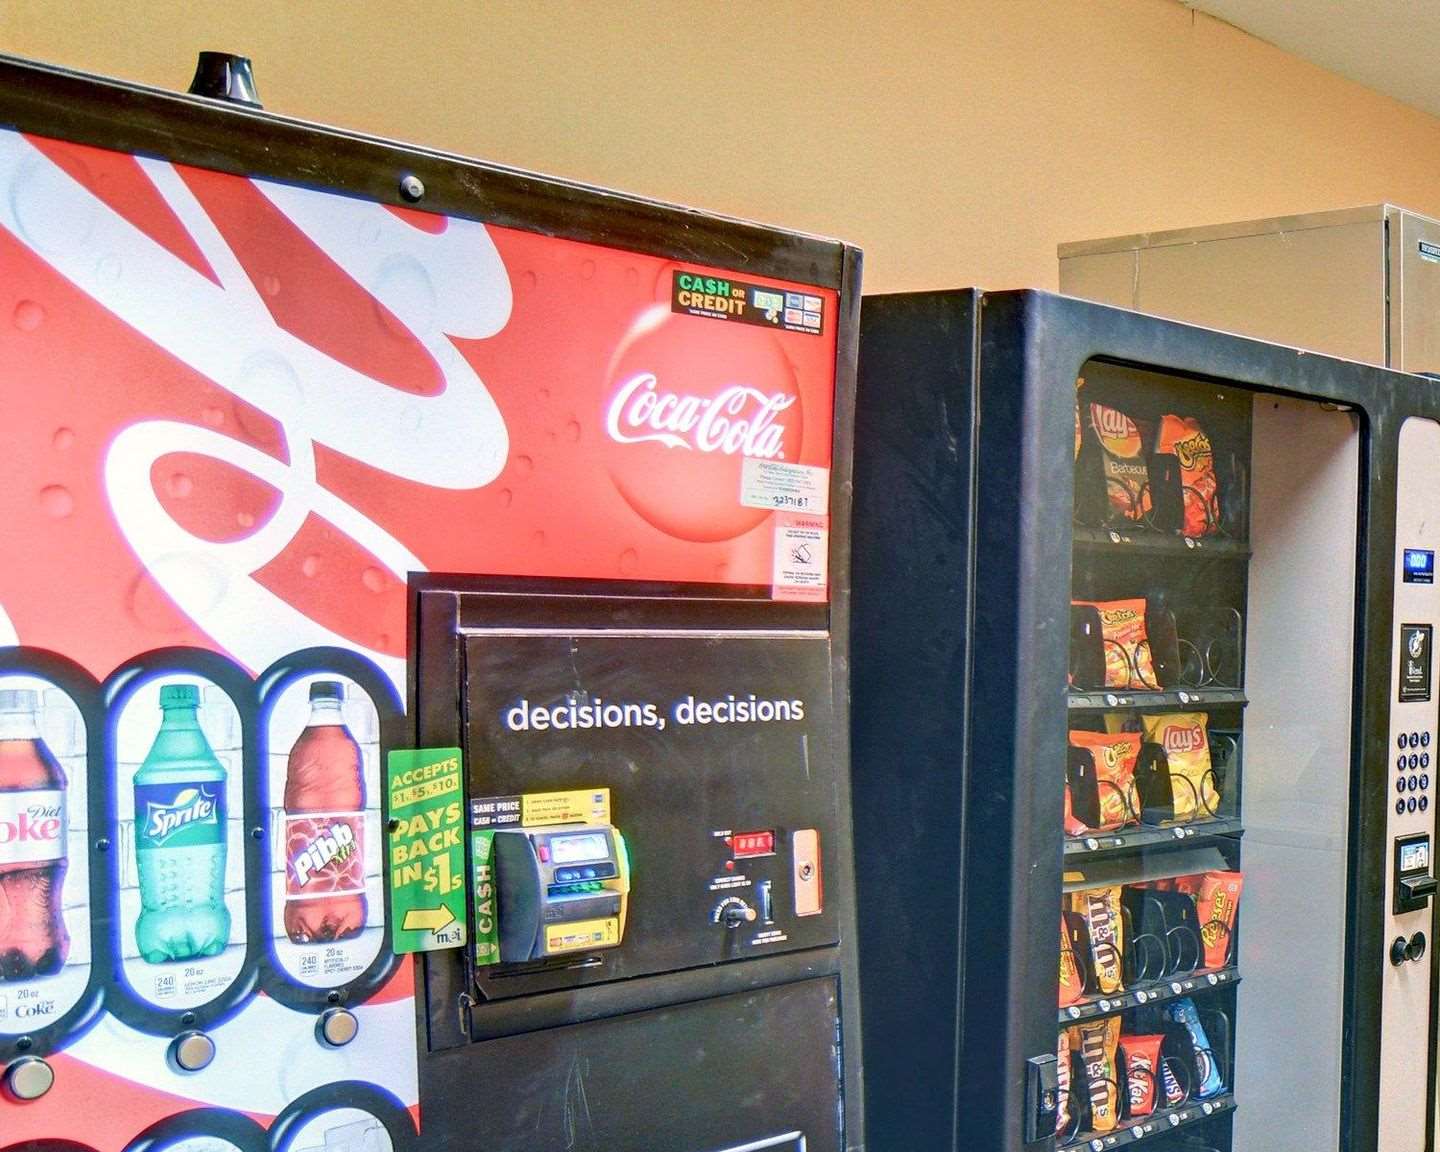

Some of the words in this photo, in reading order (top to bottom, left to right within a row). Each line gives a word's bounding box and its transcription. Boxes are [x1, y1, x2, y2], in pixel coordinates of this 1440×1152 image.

[678, 290, 746, 315] CREDIT
[732, 288, 745, 299] OR
[605, 372, 796, 459] Coca-Cola
[507, 699, 666, 730] decisions,
[675, 695, 805, 725] decisions
[392, 757, 458, 790] ACCEPTS
[27, 804, 62, 818] Diet
[149, 800, 211, 837] Sprite
[392, 803, 461, 842] PAYS
[473, 803, 495, 814] SAME
[497, 801, 520, 812] PRICE
[473, 816, 490, 825] CASH
[497, 814, 520, 823] CREDIT
[0, 813, 61, 843] oke
[294, 822, 354, 888] Pibb
[393, 826, 461, 865] BACK
[393, 862, 422, 888] IN
[477, 865, 493, 934] CASH
[185, 968, 195, 977] 20
[17, 989, 29, 999] 20
